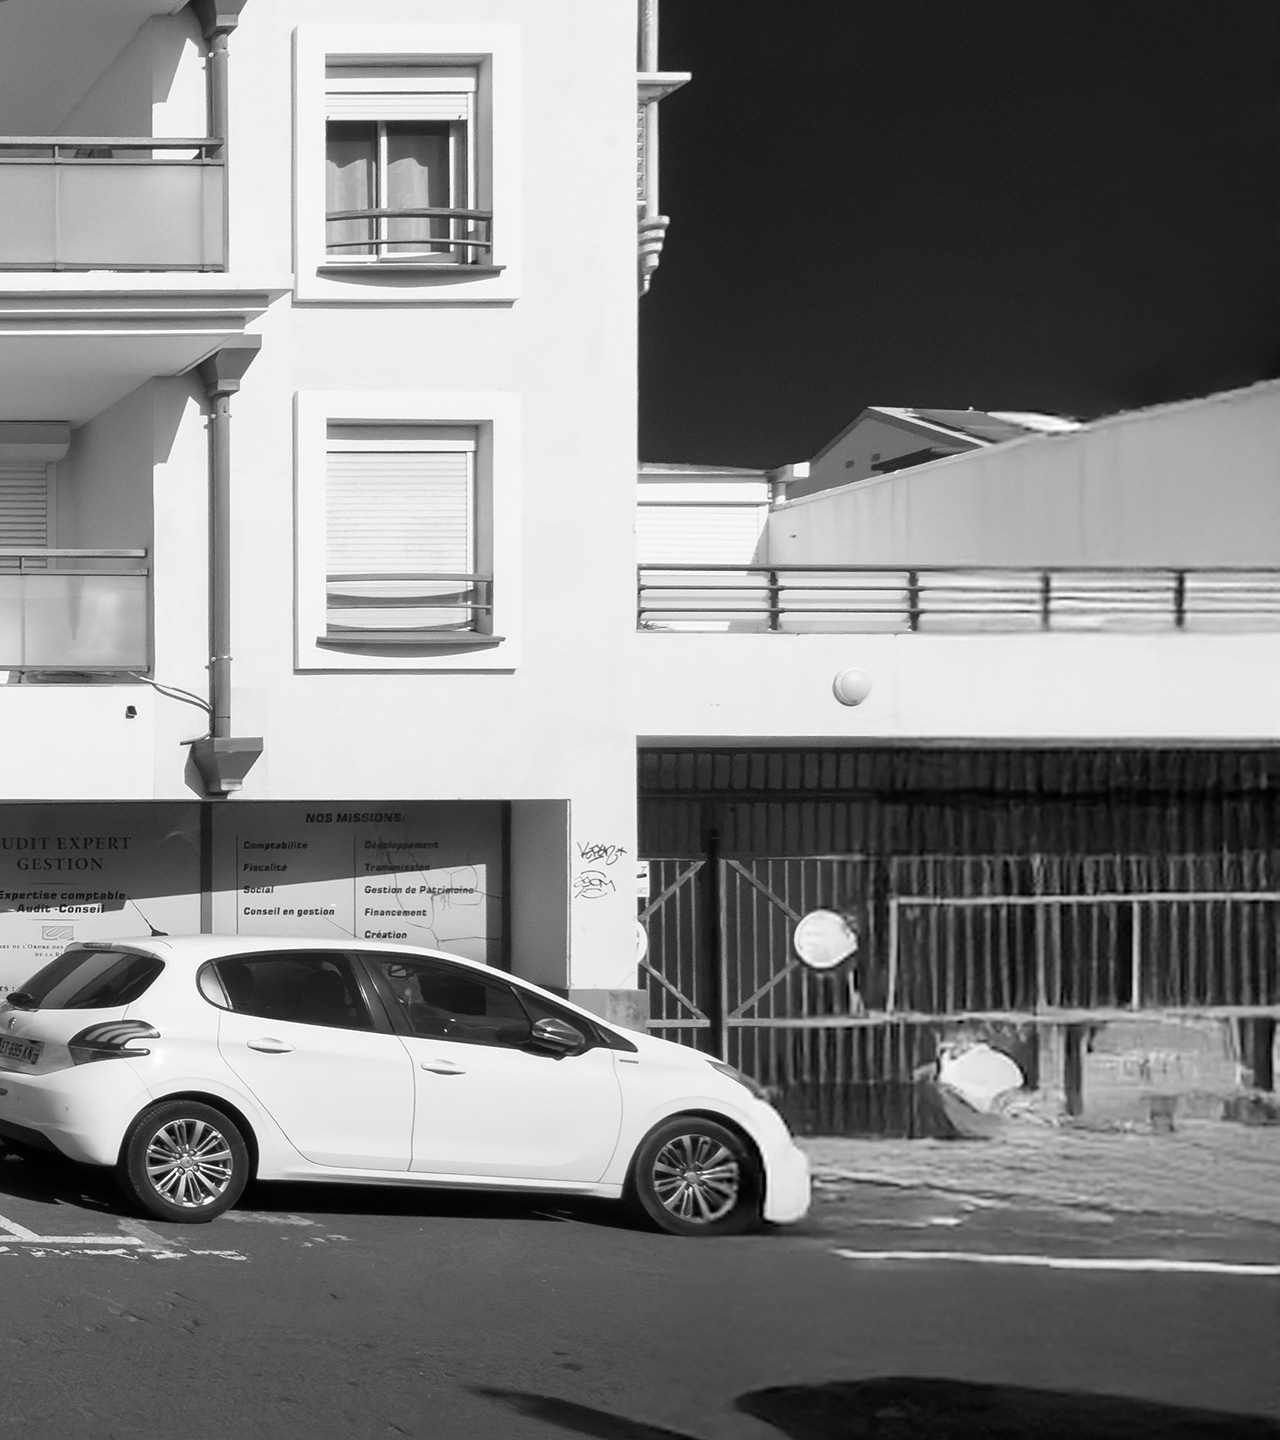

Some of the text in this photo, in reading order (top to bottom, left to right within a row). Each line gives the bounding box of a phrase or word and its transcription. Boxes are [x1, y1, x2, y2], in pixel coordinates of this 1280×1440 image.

[305, 813, 333, 823] NOS
[57, 837, 132, 850] EXPERT
[243, 840, 308, 851] Comptabilité
[17, 858, 103, 870] GESTION
[243, 863, 288, 872] Fiscalité
[243, 886, 274, 894] Social
[364, 886, 474, 895] Gestion de Patrimoine
[60, 891, 126, 902] comptable
[16, 904, 51, 913] Audit
[243, 907, 280, 916] Conseil
[297, 907, 335, 918] gestion
[364, 908, 427, 917] Financement
[364, 931, 407, 939] Création
